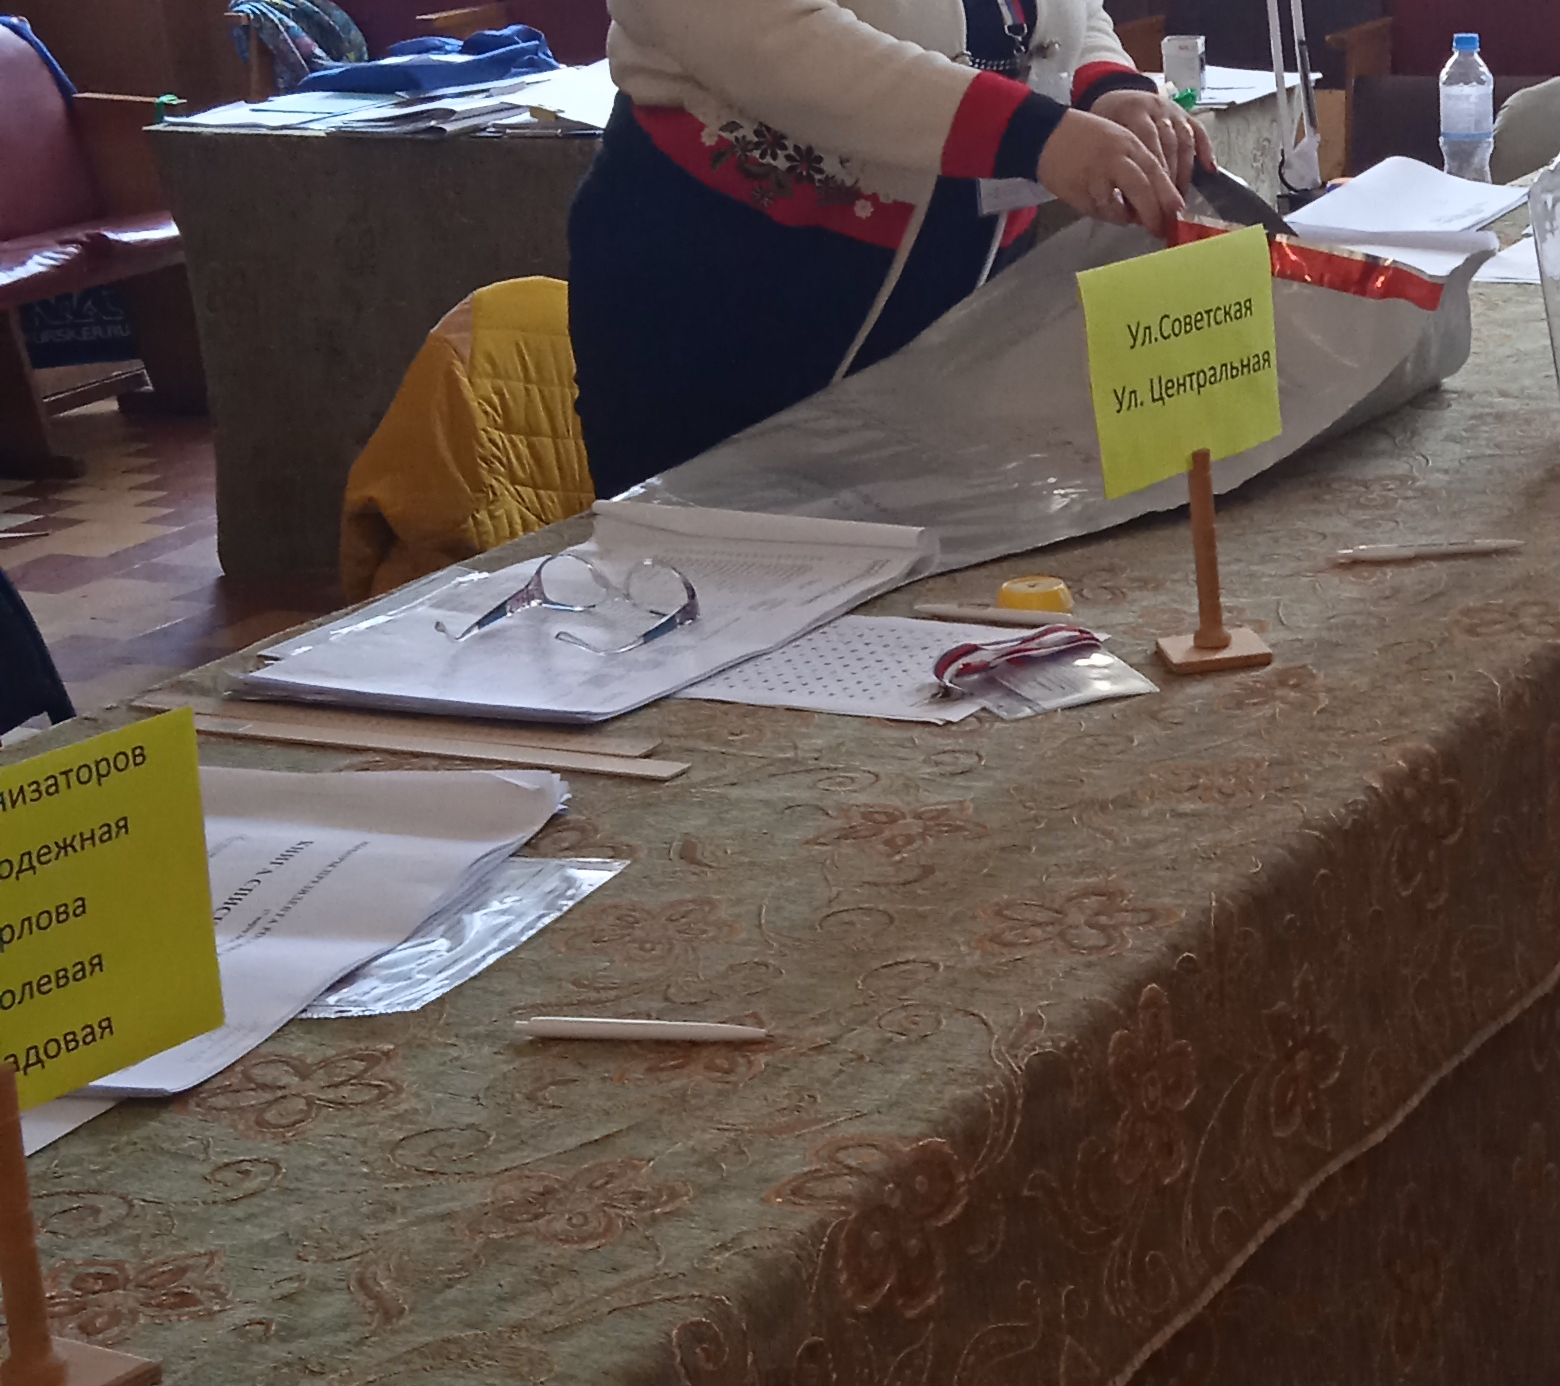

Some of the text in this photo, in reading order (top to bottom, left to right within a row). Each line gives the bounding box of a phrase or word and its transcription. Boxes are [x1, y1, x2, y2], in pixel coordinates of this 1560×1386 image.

[1126, 296, 1254, 350] Ул.Советская
[1112, 349, 1272, 414] Ул. Центральная
[0, 953, 105, 1011] олевая
